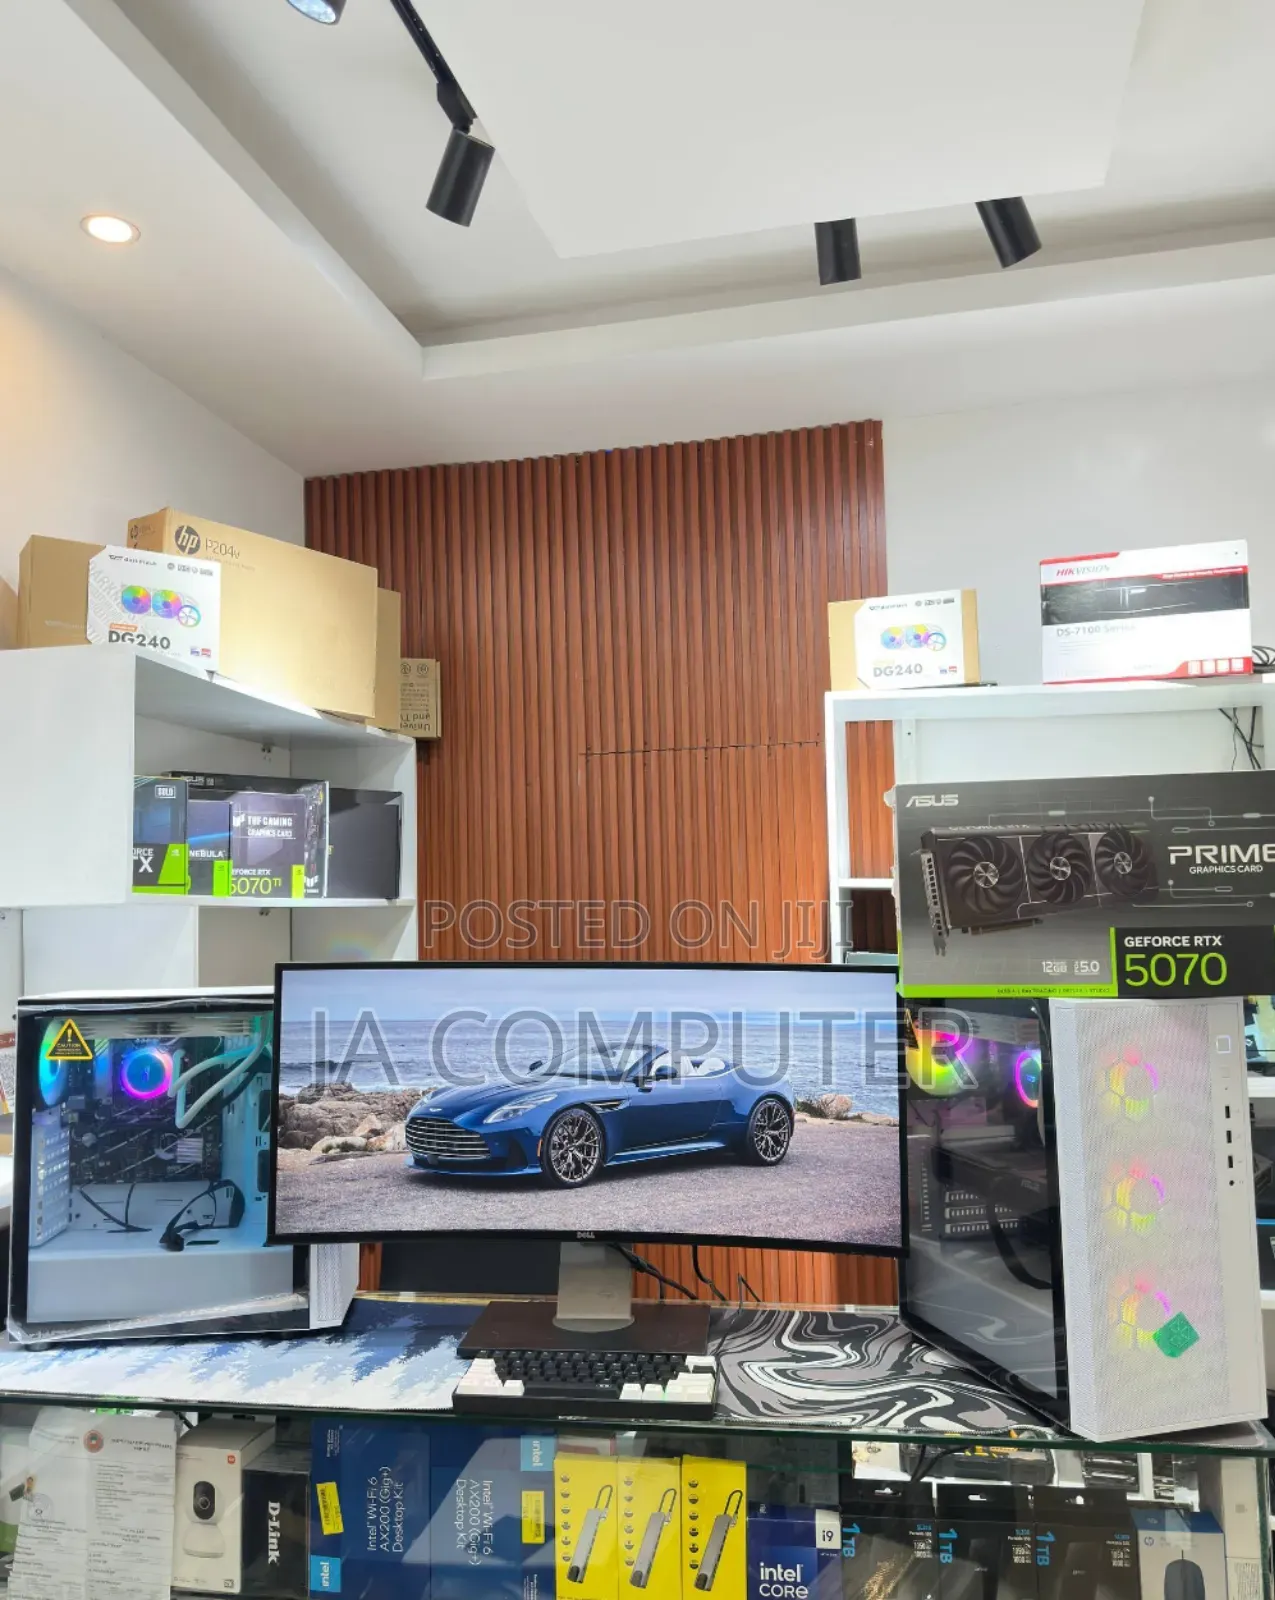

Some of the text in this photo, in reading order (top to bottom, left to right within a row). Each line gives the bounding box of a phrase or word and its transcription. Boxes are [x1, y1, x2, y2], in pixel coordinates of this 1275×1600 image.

[177, 524, 240, 559] hp P204v
[1056, 564, 1110, 577] HIKVISION
[108, 630, 171, 650] DG240
[1056, 624, 1100, 637] DS-7100
[873, 663, 923, 678] DG240
[905, 794, 959, 808] ASUS
[247, 815, 292, 827] TUF GAMING
[188, 849, 222, 858] NEBULA
[1167, 843, 1275, 865] PRIME
[1189, 864, 1264, 875] GRAPHICS CARD
[231, 877, 272, 895] 5070
[1124, 935, 1222, 948] GEFORCE RTX
[1124, 952, 1228, 987] 5070
[532, 1440, 544, 1467] intel
[368, 1476, 378, 1485] 6
[366, 1490, 377, 1520] Wi-Fi
[379, 1466, 392, 1552] AX200 (Gig+)
[454, 1480, 467, 1549] Desktop Kit
[392, 1482, 406, 1553] Desktop Kit
[468, 1480, 482, 1565] AX200 (Gig+)
[268, 1500, 281, 1564] D-Link
[483, 1512, 494, 1544] Wi-Fi
[822, 1530, 834, 1542] i9
[482, 1546, 493, 1555] 6
[842, 1538, 855, 1558] TB
[940, 1543, 952, 1564] TB
[1036, 1546, 1050, 1566] TB
[320, 1562, 330, 1587] intel
[760, 1562, 801, 1582] intel
